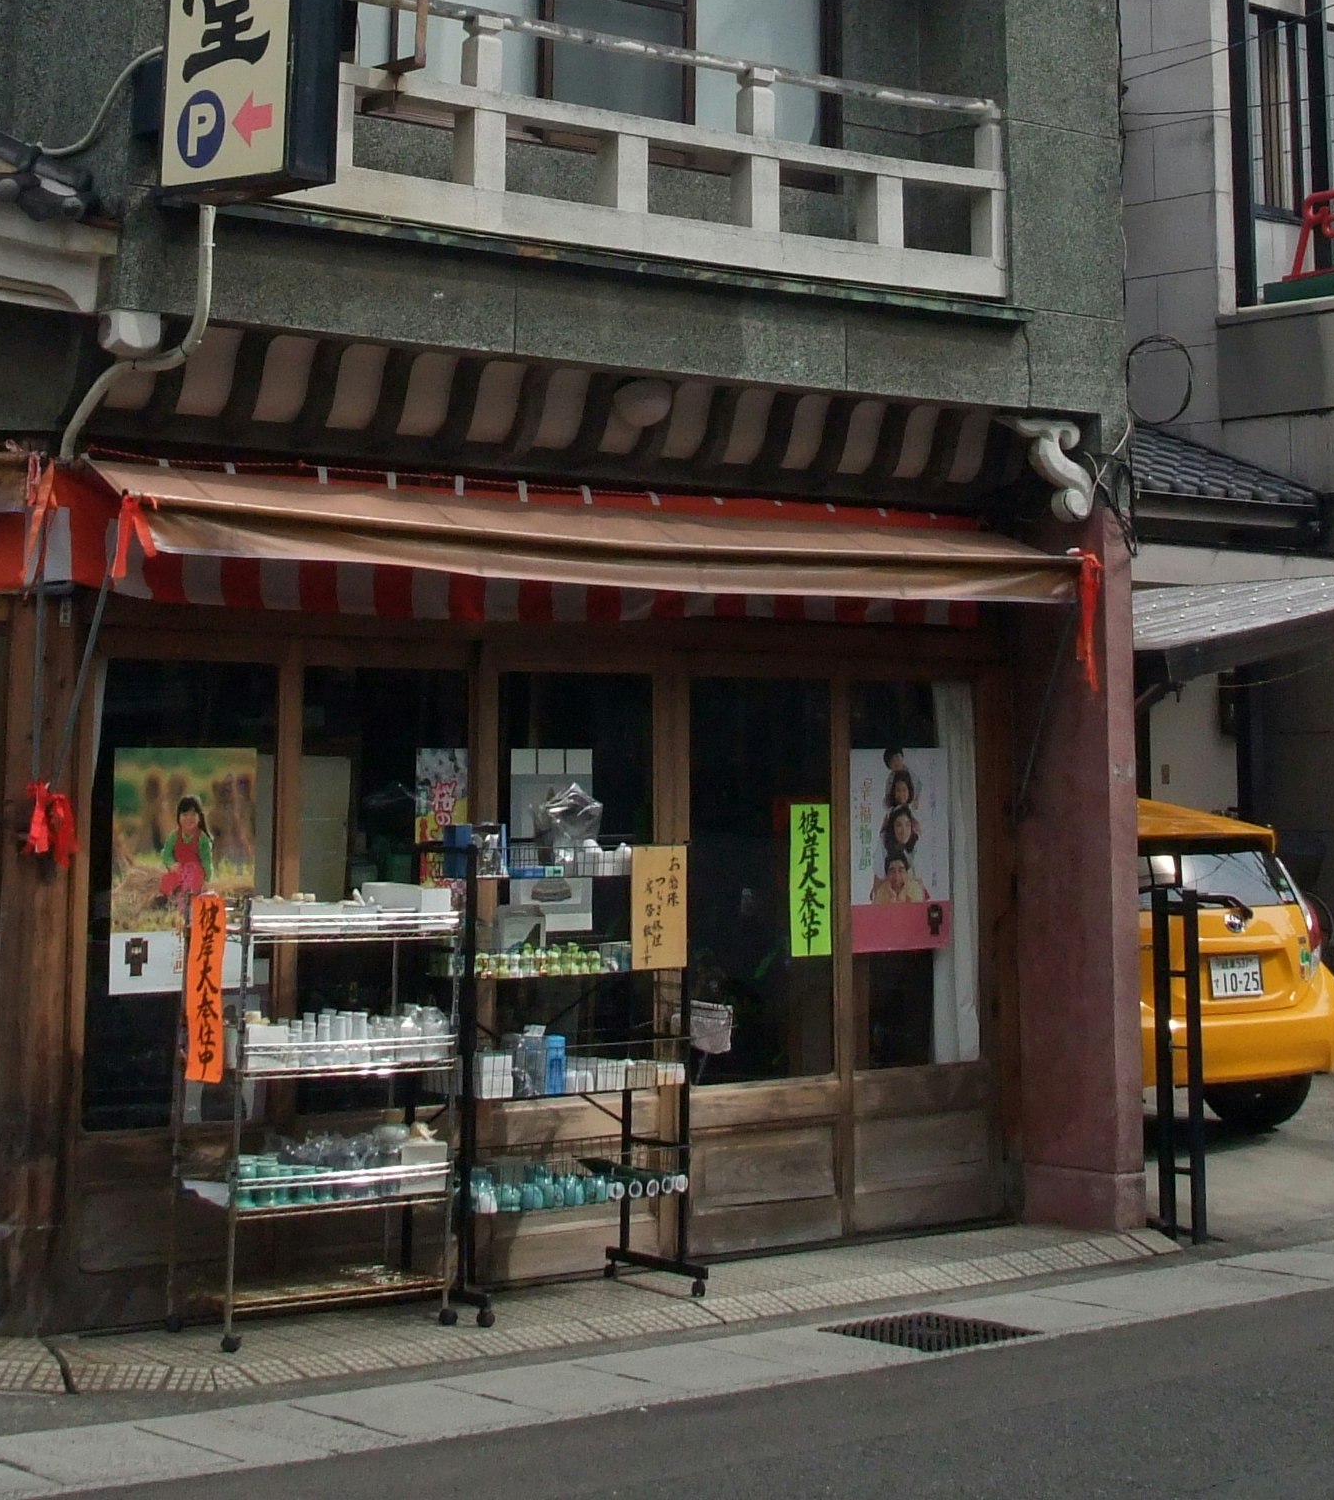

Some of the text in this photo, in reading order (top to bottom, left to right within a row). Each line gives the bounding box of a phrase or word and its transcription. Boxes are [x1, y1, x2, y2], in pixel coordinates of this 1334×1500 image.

[187, 102, 217, 157] P
[798, 806, 826, 955] 彼岸大奉仕中
[195, 902, 221, 1080] 彼岸大奉仕中
[1223, 971, 1260, 993] 10-25
